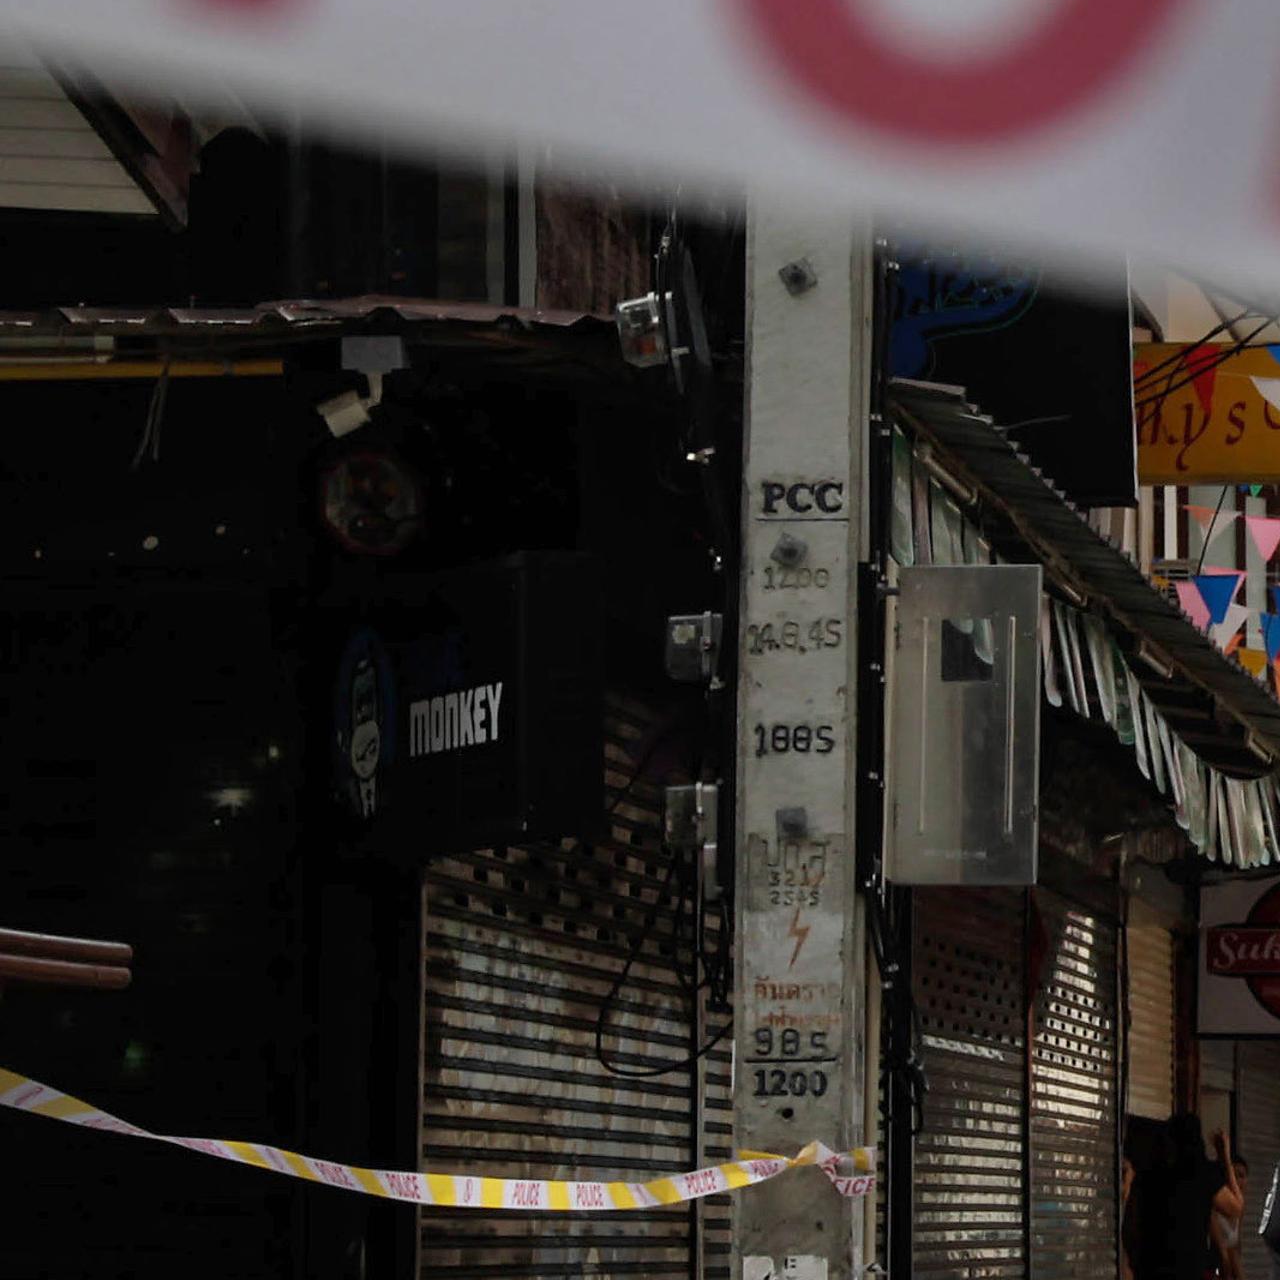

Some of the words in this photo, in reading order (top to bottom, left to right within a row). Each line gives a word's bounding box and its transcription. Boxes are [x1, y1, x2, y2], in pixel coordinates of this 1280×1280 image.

[762, 482, 843, 514] PCC
[753, 1070, 828, 1097] 1200
[514, 1183, 541, 1206] POLICE
[576, 1184, 604, 1208] POLICE
[686, 1169, 717, 1193] POLICE
